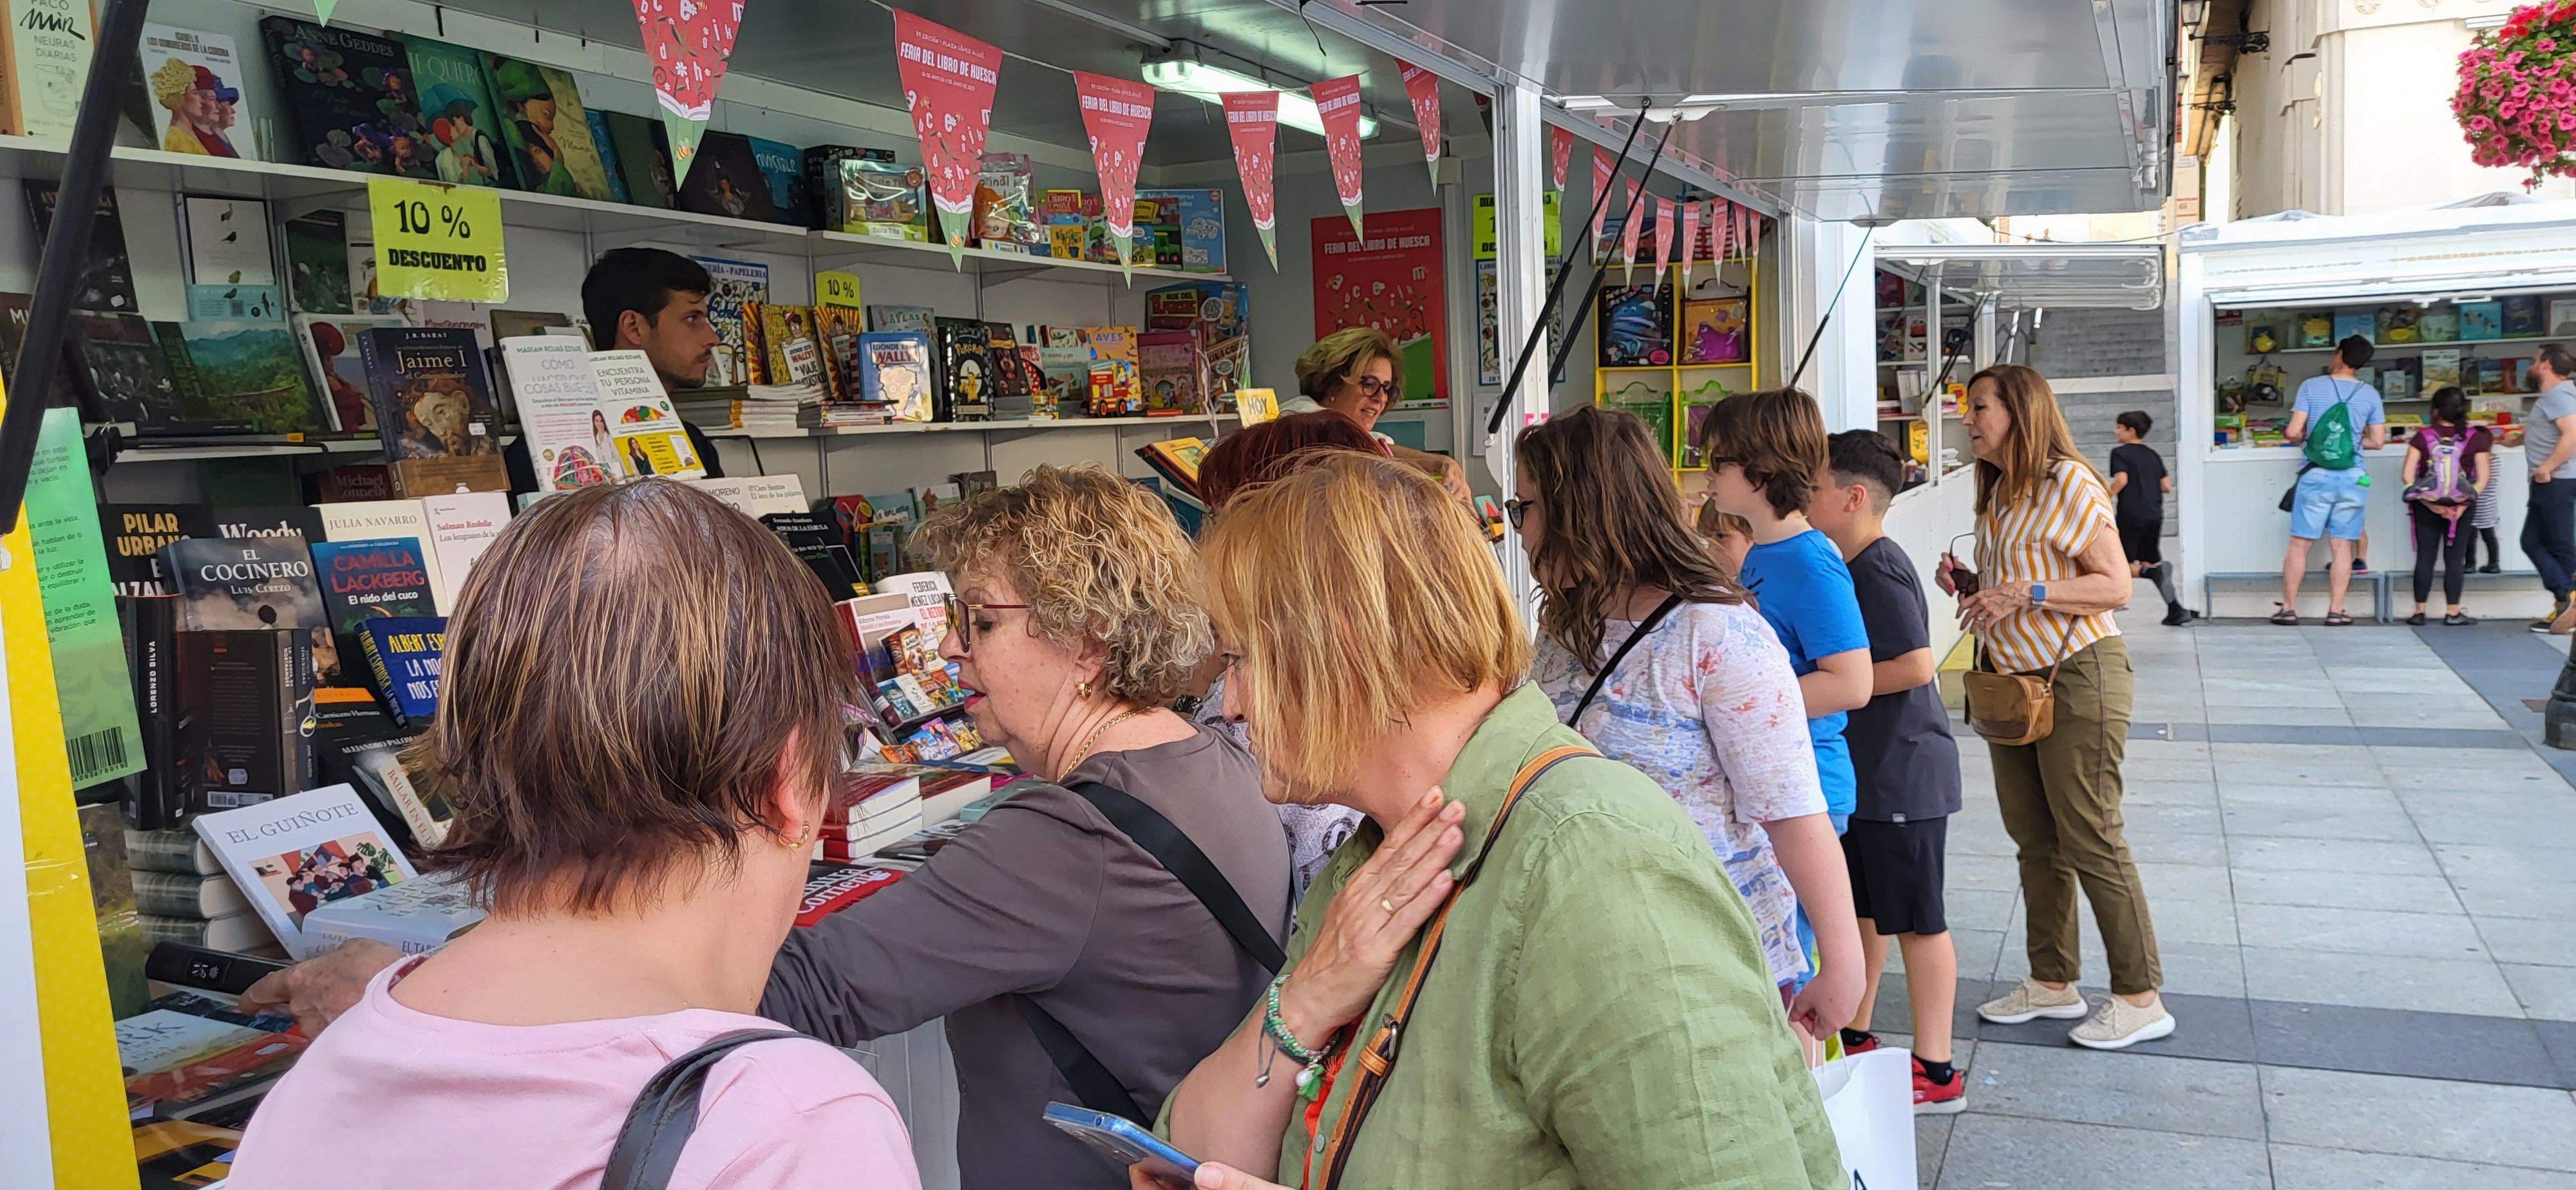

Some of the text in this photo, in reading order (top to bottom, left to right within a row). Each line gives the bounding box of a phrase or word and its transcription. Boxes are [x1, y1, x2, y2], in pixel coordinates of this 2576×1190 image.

[34, 35, 76, 50] NEURAS
[295, 24, 395, 57] ANNE GEDDES
[35, 48, 78, 62] DIARIAS
[900, 42, 921, 63] FERIA
[922, 49, 935, 67] DEL
[937, 53, 958, 73] LIBRO
[960, 61, 969, 77] DE
[971, 64, 998, 86] HUESCA
[1082, 95, 1152, 120] FERIA DEL LIBRO DE HUESCA
[1047, 193, 1071, 203] LIBRO
[394, 200, 471, 239] 10 %
[1052, 246, 1063, 258] 10
[1325, 235, 1430, 254] FERIA DEL LIBRO DE HUESCA
[388, 249, 487, 272] DESCUENTO
[827, 279, 855, 298] 10 %
[889, 312, 921, 324] ATLAS
[1095, 332, 1124, 343] AVES
[395, 350, 468, 375] Jaime I
[541, 357, 575, 371] CÓMO
[596, 366, 646, 377] ENCUENTRA
[524, 382, 562, 395] COSAS
[600, 376, 652, 388] TU PERSONA
[611, 387, 650, 397] VITAMINA
[1247, 397, 1268, 415] HOY
[336, 473, 383, 484] Michael
[122, 513, 180, 533] PILAR
[330, 515, 418, 530] JULIA NAVARRO
[242, 549, 261, 561] EL
[332, 549, 415, 572] CAMILLA
[53, 560, 77, 571] utilizar
[57, 567, 84, 578] destruir
[151, 558, 162, 578] E
[201, 561, 308, 581] COCINERO
[48, 577, 80, 590] equilibrar
[348, 591, 419, 606] El nido del cuco
[55, 612, 86, 624] aprender
[50, 622, 82, 633] vibración
[359, 630, 379, 657] ALBERT
[388, 634, 427, 654] ALBERT
[405, 659, 424, 677] LA
[149, 669, 158, 713] LORENZO
[406, 681, 432, 700] NOS
[386, 735, 416, 748] PALOM
[388, 769, 412, 808] BAILAR
[225, 802, 359, 844] EL GUIÑOTE
[402, 940, 413, 954] EL
